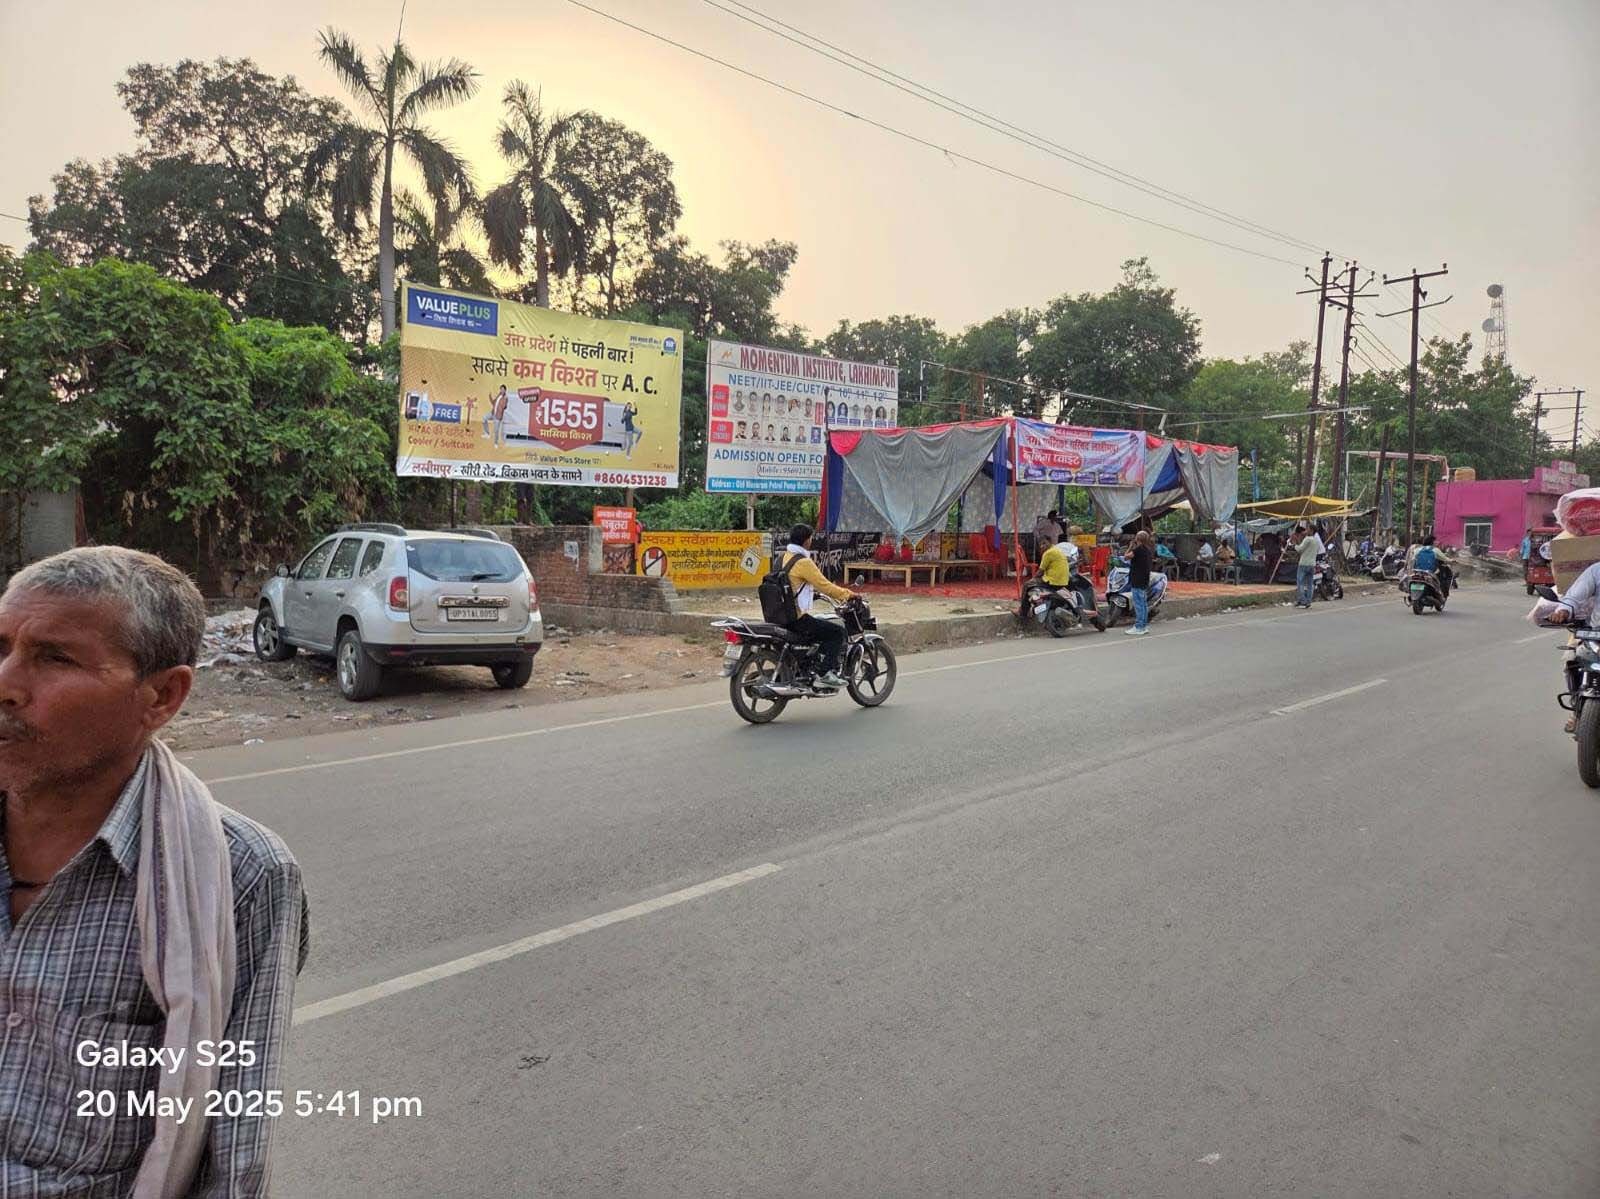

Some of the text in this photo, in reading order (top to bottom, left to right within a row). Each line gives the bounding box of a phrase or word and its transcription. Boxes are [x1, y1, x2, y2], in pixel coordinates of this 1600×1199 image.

[416, 295, 491, 320] VALUEPLUS
[504, 332, 526, 348] उत्तर
[529, 335, 556, 353] प्रदेश
[559, 336, 569, 354] में
[572, 341, 605, 359] पहली
[607, 347, 628, 363] बार
[471, 355, 509, 376] सबसे
[512, 358, 547, 380] कम
[550, 358, 599, 388] किश्त
[602, 374, 619, 391] पर
[849, 363, 896, 388] LAKHIMPUR
[434, 407, 458, 419] FREE
[539, 428, 592, 441] मासिक किश्त
[407, 435, 433, 446] Cooler
[440, 439, 474, 450] Suitcase
[559, 456, 573, 464] Plus
[713, 449, 823, 464] ADMISSION OPEN FO
[412, 460, 452, 477] लखीमपुर
[460, 462, 481, 476] खीरी
[501, 465, 529, 479] विकास
[530, 468, 549, 479] भवन
[550, 467, 560, 480] के
[561, 468, 582, 481] सामने
[594, 472, 667, 486] #8604531238
[726, 535, 761, 545] 2024-2
